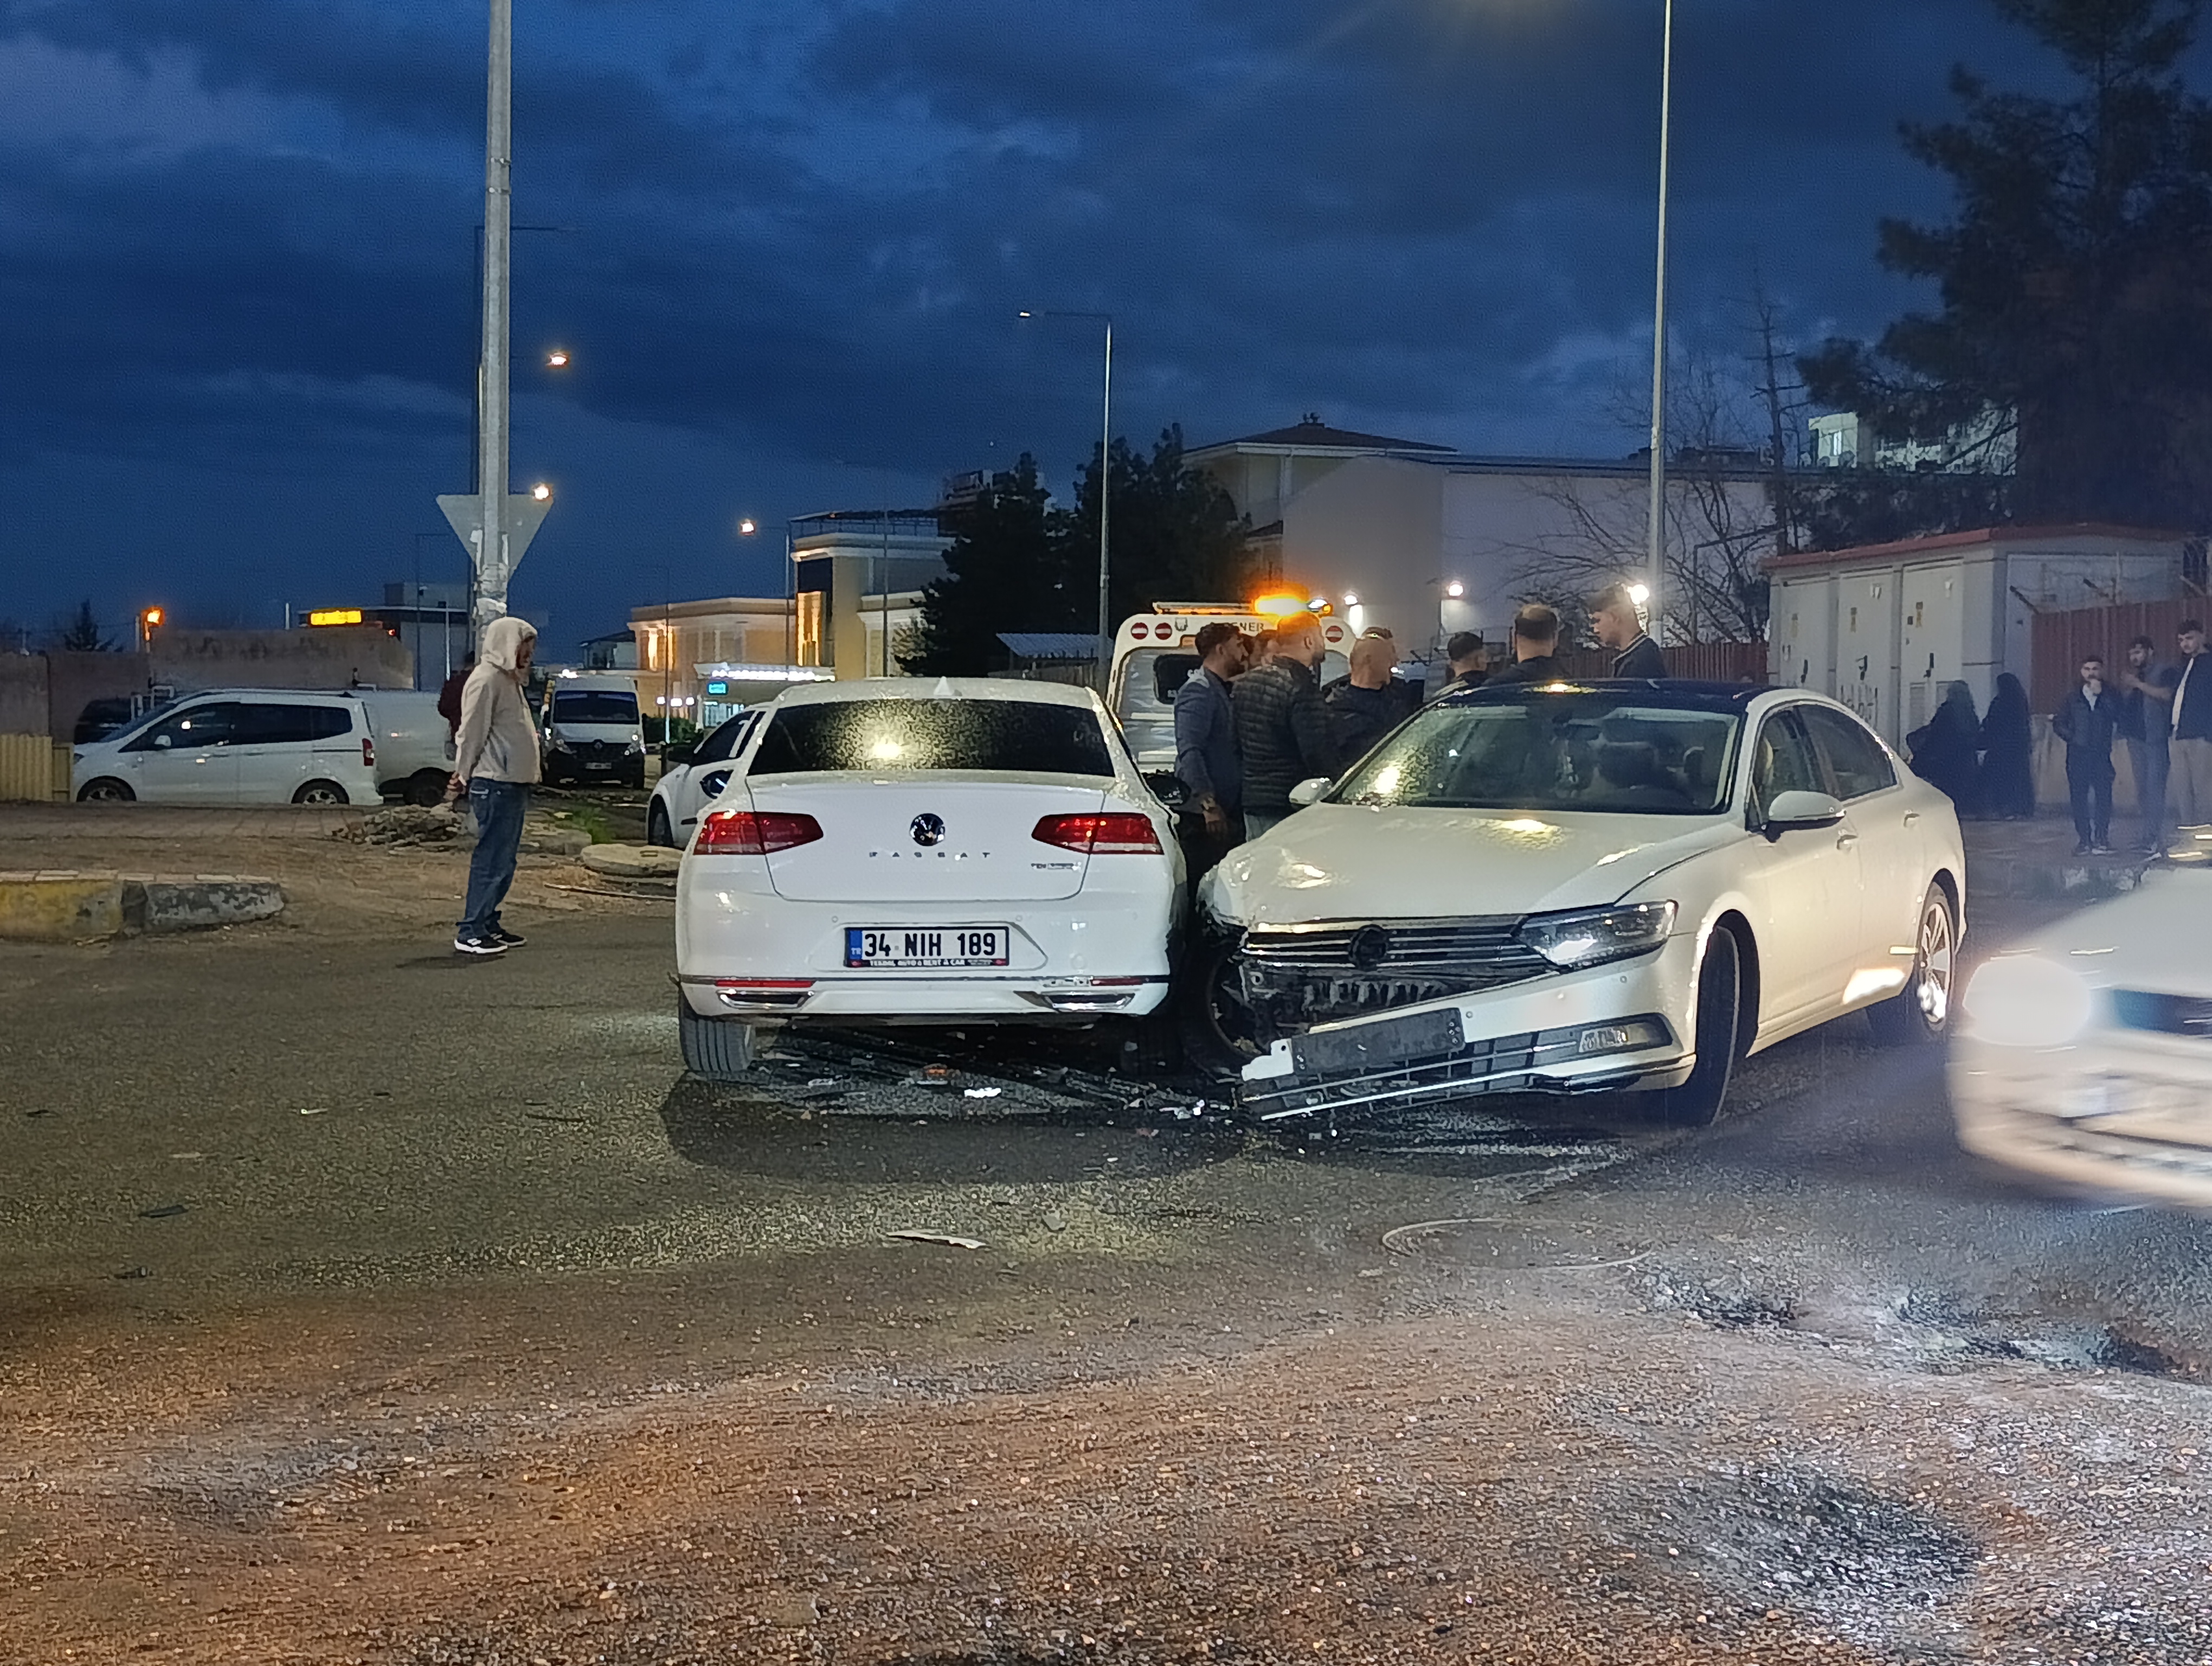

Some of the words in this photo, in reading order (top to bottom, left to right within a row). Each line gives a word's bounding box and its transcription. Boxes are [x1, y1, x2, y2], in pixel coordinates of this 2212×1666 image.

[851, 947, 861, 955] TR
[865, 933, 891, 957] 34
[905, 933, 941, 957] NIH
[957, 932, 995, 956] 189
